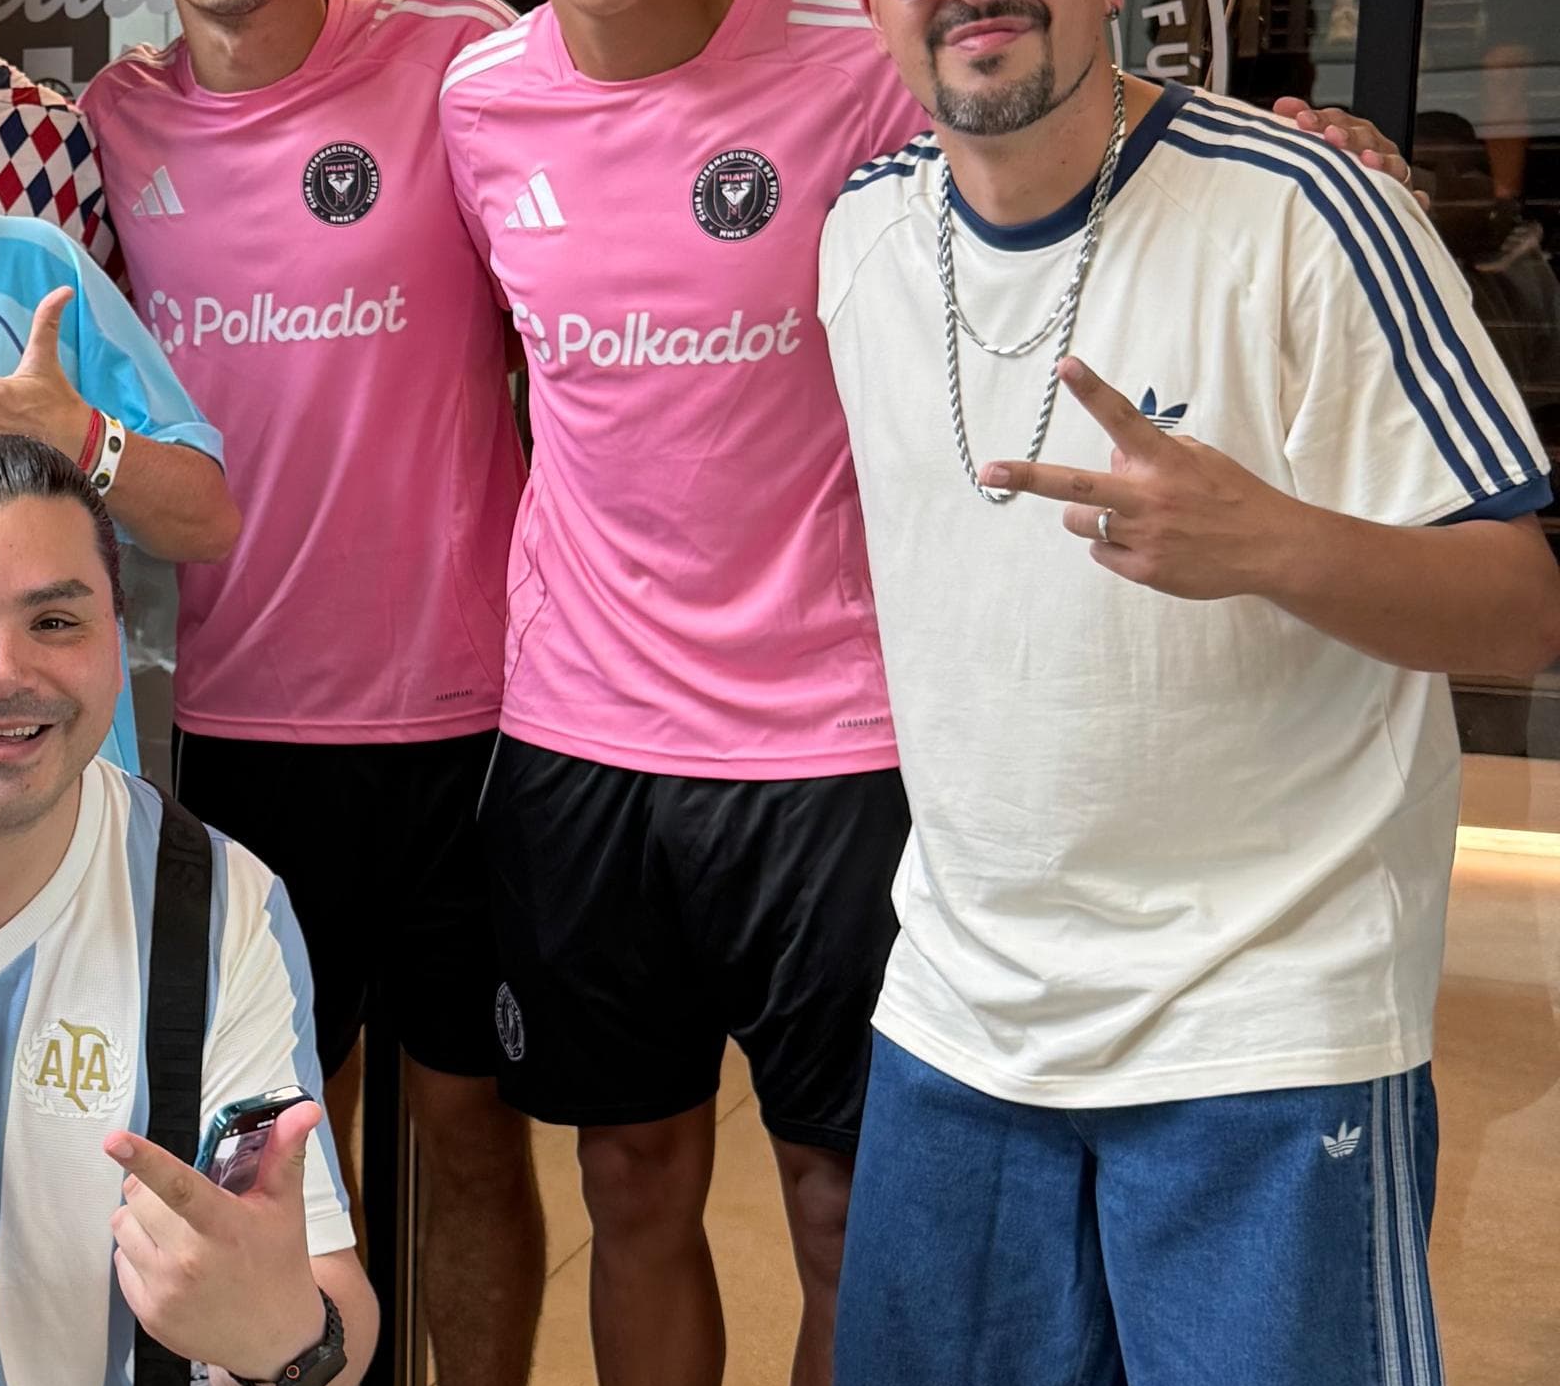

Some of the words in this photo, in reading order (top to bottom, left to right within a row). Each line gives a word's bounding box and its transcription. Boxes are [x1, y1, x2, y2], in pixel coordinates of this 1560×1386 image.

[718, 172, 754, 182] MIAMI
[192, 285, 407, 348] Polkadot
[558, 308, 803, 368] Polkadot
[34, 1018, 111, 1113] AFA
